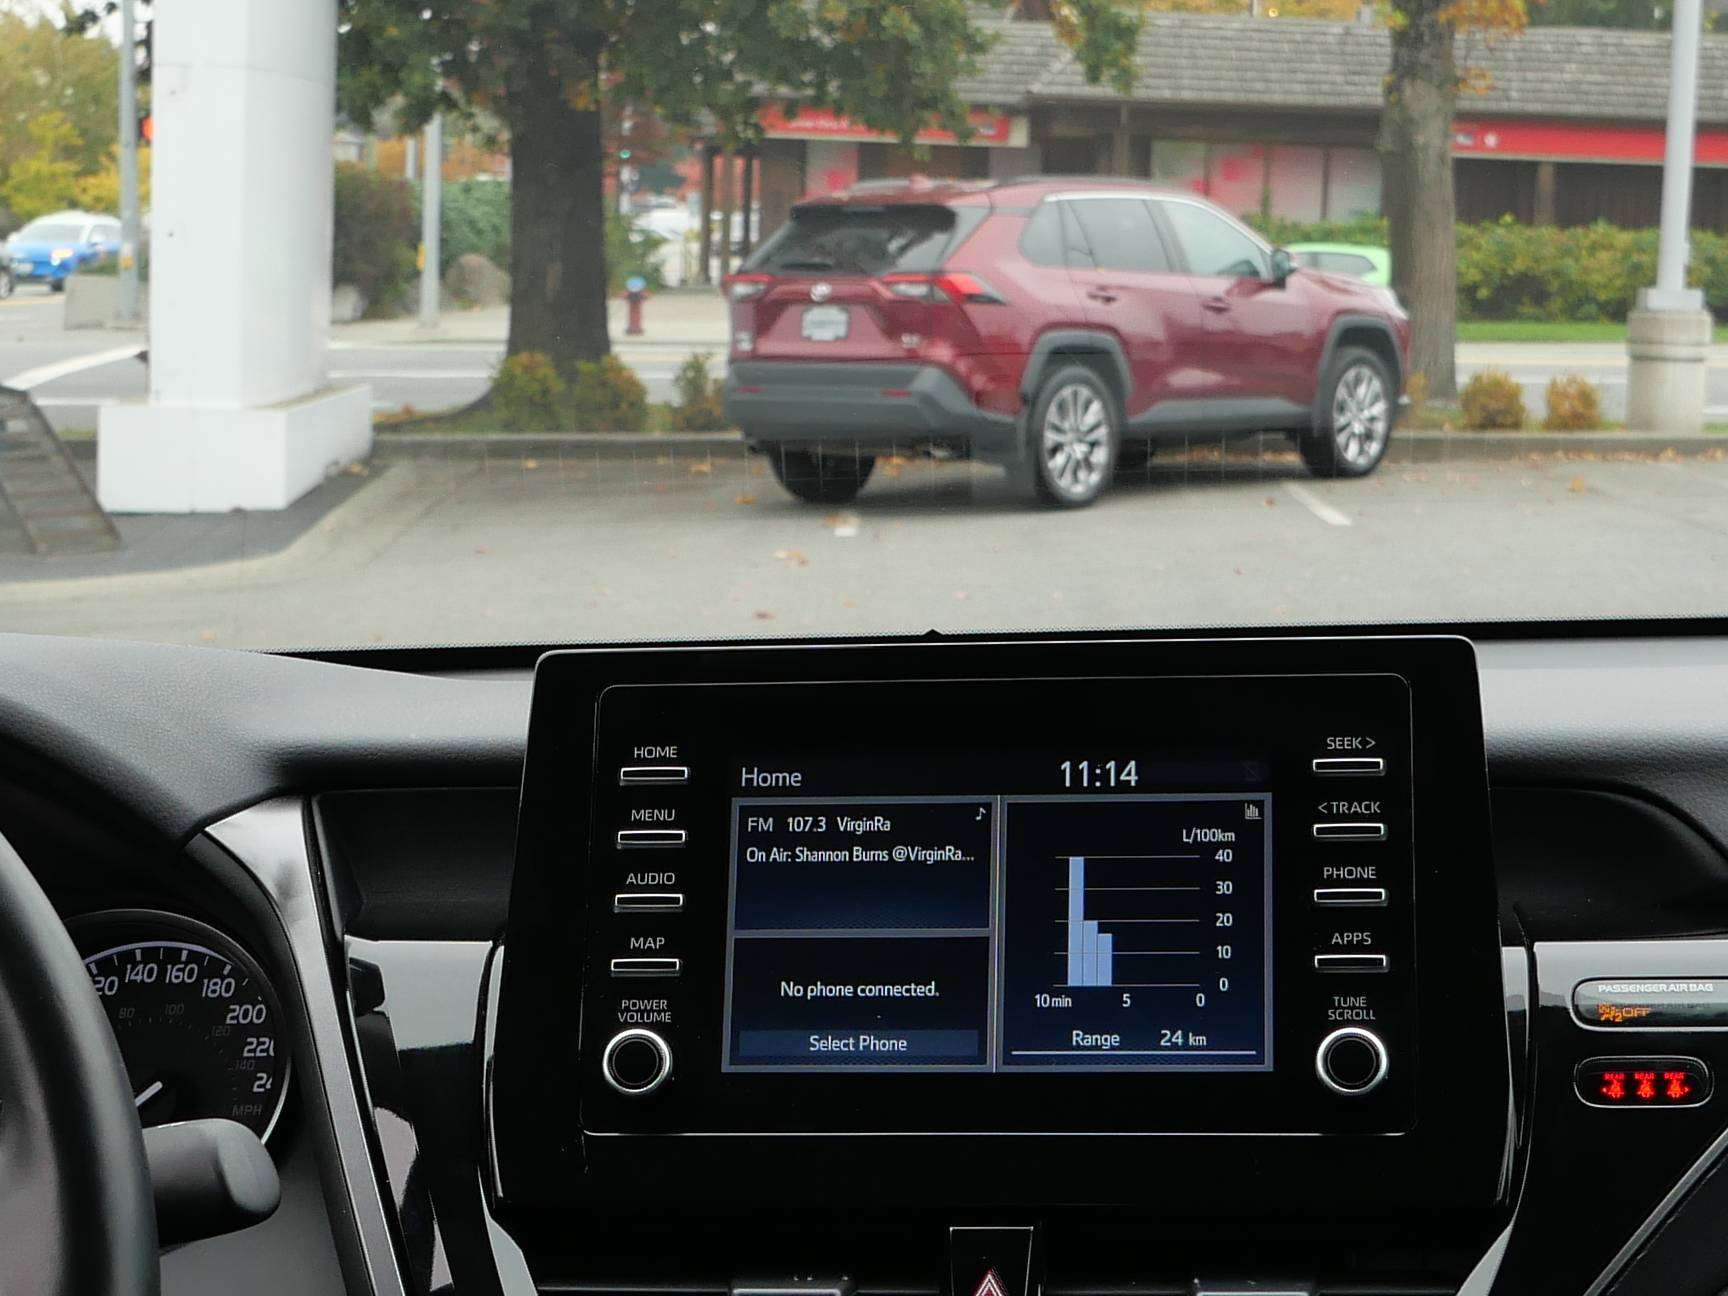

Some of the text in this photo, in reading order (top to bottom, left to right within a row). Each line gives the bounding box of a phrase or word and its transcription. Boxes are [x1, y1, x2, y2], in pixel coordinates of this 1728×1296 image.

[1326, 736, 1362, 750] SEEK
[633, 745, 678, 759] HOME
[740, 766, 803, 788] Home
[1060, 759, 1139, 787] 11:14
[1330, 800, 1381, 814] TRACK
[630, 809, 675, 822] MENU
[747, 815, 892, 836] FM 107.3 VirginRa
[1182, 828, 1236, 844] L/100km
[745, 847, 766, 862] On
[769, 846, 792, 862] Air:
[794, 846, 850, 862] Shannon
[852, 846, 890, 862] Burns
[1214, 848, 1233, 863] 40
[626, 871, 676, 886] AUDIO
[1323, 866, 1377, 879] PHONE
[1215, 880, 1233, 894] 30
[1215, 913, 1233, 927] 20
[629, 937, 665, 950] MAP
[1331, 932, 1372, 946] APPS
[1216, 945, 1232, 959] 10
[125, 963, 198, 983] 140 160
[94, 975, 119, 996] 20
[201, 977, 236, 998] 180
[779, 980, 940, 1000] No phone connected.
[1219, 977, 1229, 991] 0
[1597, 983, 1668, 994] PASSENGER
[1669, 983, 1689, 993] AIR
[621, 999, 668, 1011] POWER
[1122, 994, 1131, 1008] 5
[1195, 993, 1205, 1007] 0
[1334, 996, 1367, 1008] TUNE
[225, 1004, 267, 1025] 200
[618, 1011, 672, 1023] VOLUME
[1328, 1009, 1376, 1021] SCROLL
[1622, 1006, 1652, 1018] OFF
[242, 1037, 275, 1057] 22
[809, 1035, 908, 1052] Select Phone
[1071, 1030, 1207, 1050] Range 24 km
[231, 1104, 262, 1117] MPH
